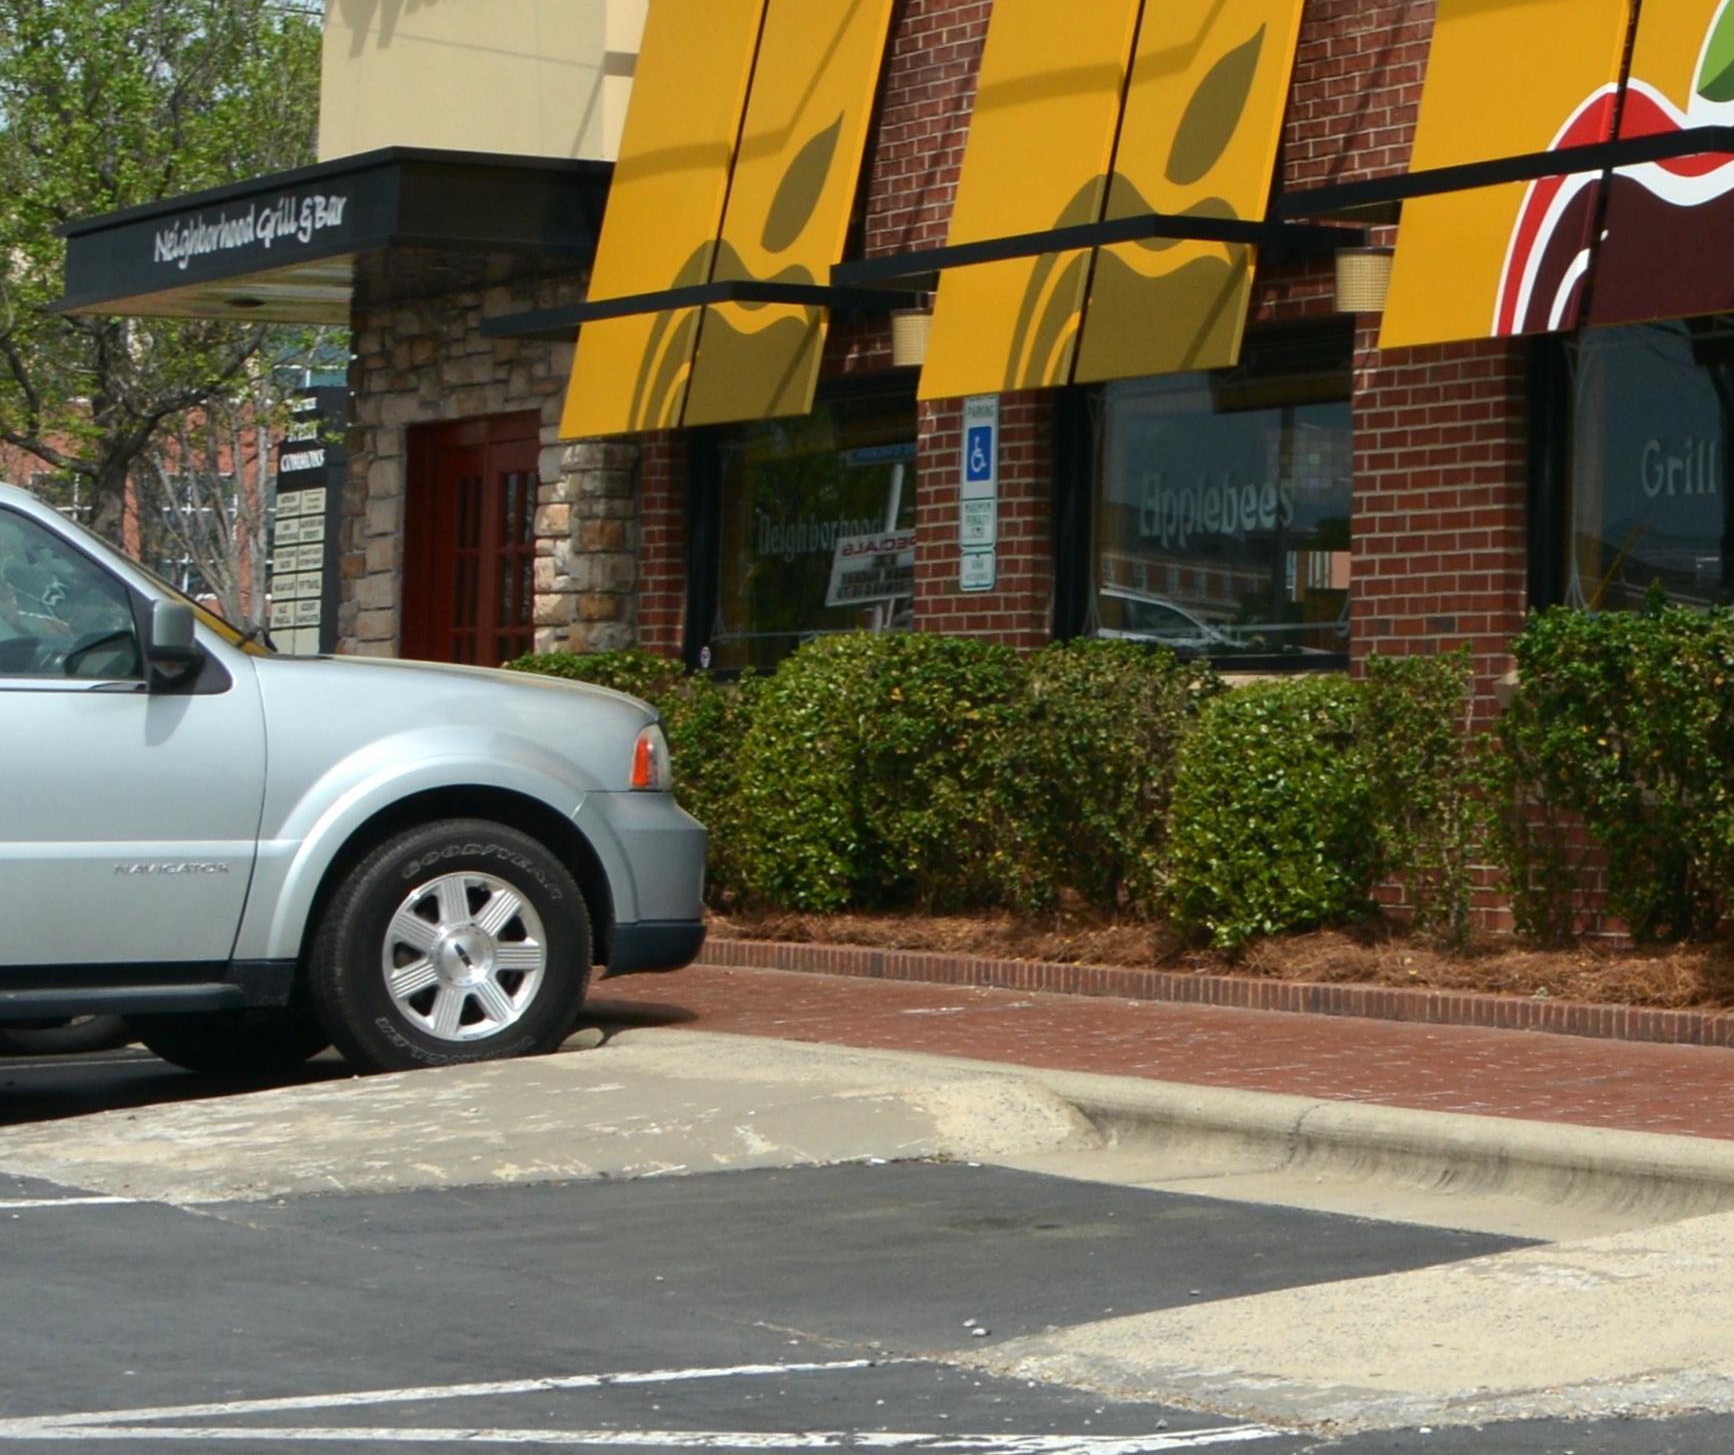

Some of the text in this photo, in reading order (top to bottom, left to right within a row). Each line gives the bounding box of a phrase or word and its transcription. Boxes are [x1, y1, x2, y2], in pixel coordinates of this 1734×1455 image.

[154, 204, 255, 270] Neighborhood
[256, 198, 298, 248] Grill
[314, 195, 347, 230] Bar
[1641, 438, 1718, 497] Grill
[113, 862, 229, 875] NAVIGATOR
[403, 843, 562, 900] GOODYEAR
